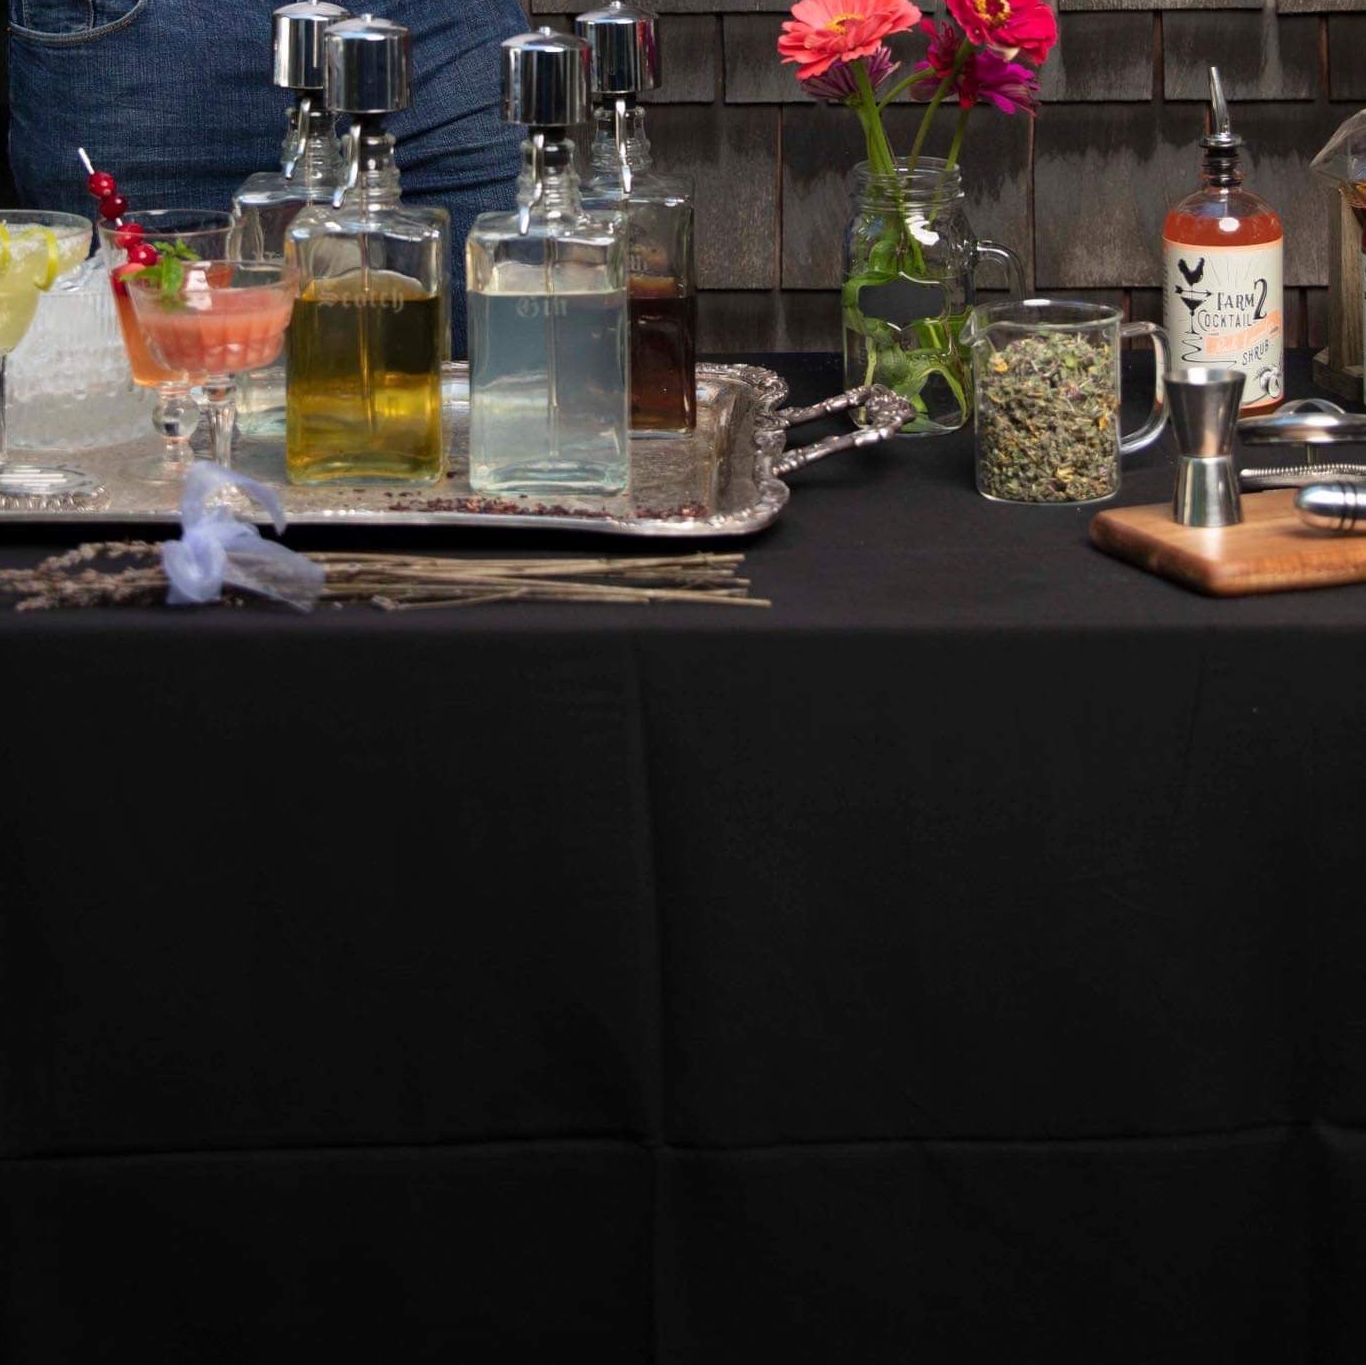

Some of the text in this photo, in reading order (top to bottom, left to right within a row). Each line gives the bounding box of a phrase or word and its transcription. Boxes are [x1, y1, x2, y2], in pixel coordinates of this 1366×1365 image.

[317, 287, 405, 314] Scotch
[1197, 309, 1253, 331] COCKTAIL
[1242, 338, 1269, 365] SHRUB
